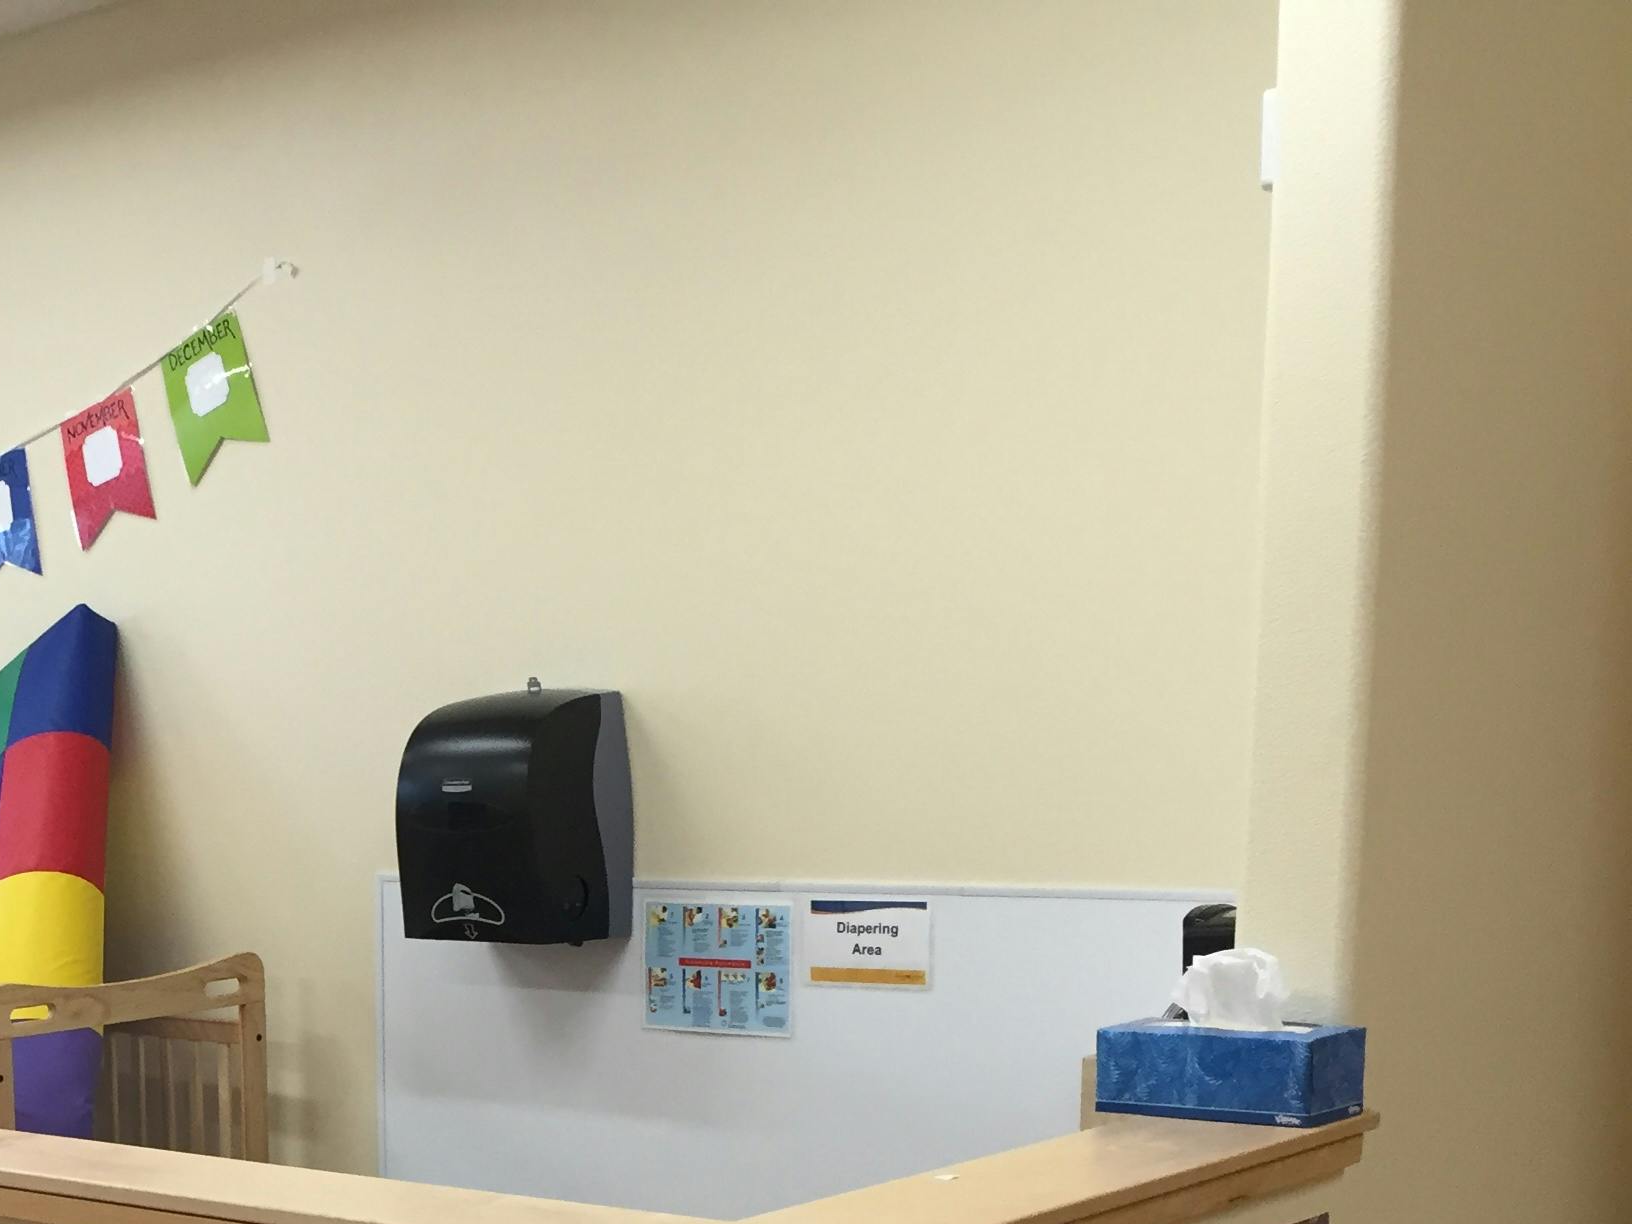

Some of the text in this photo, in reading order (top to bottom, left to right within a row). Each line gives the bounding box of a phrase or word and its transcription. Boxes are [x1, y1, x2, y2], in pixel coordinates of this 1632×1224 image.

[169, 318, 236, 372] DECEMBER
[66, 399, 130, 442] NOVEMBER
[836, 921, 899, 938] Diapering
[852, 943, 882, 956] Area
